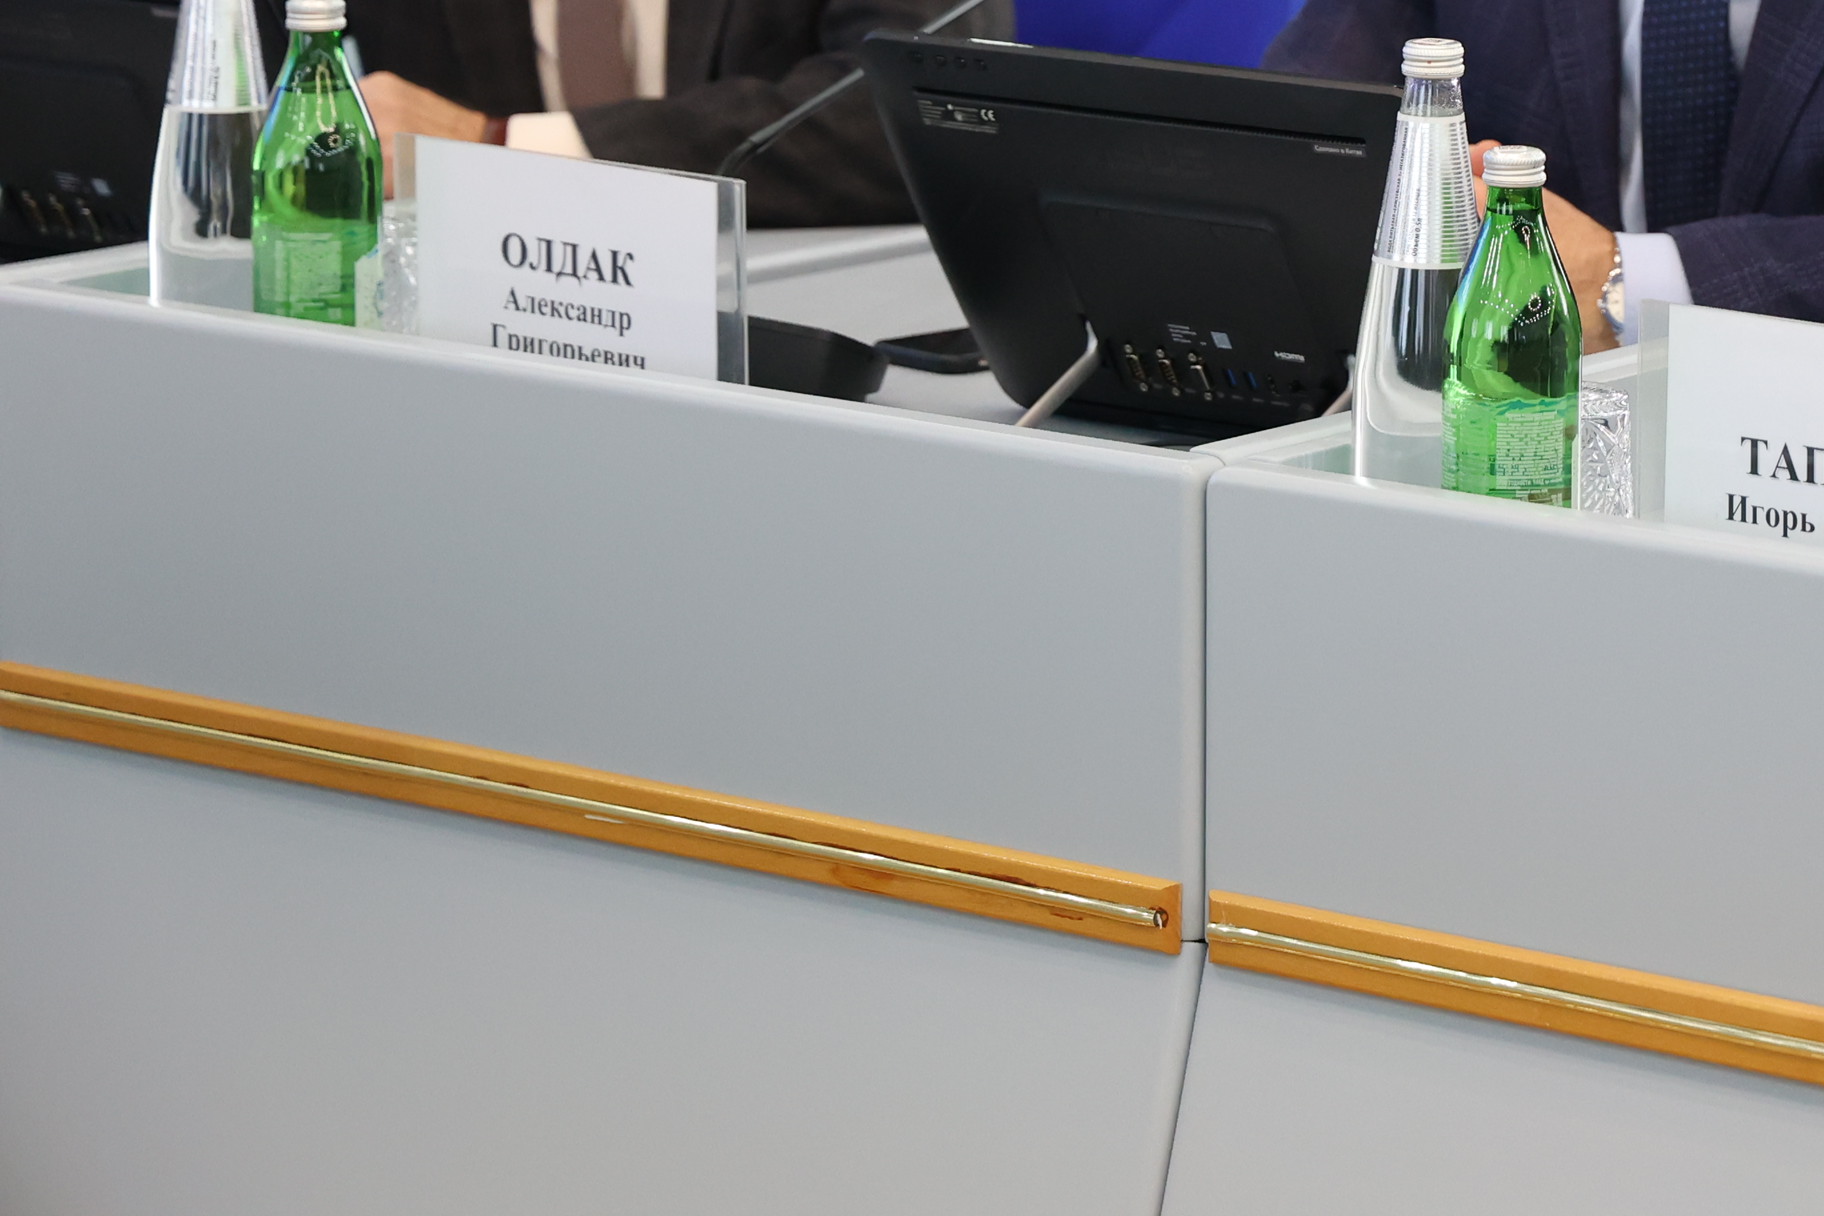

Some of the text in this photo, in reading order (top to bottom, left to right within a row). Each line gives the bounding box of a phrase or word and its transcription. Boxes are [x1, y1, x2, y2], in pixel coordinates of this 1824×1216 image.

[501, 232, 635, 286] ОЛДАК
[503, 287, 632, 336] Александр
[1725, 492, 1816, 539] Игорь
